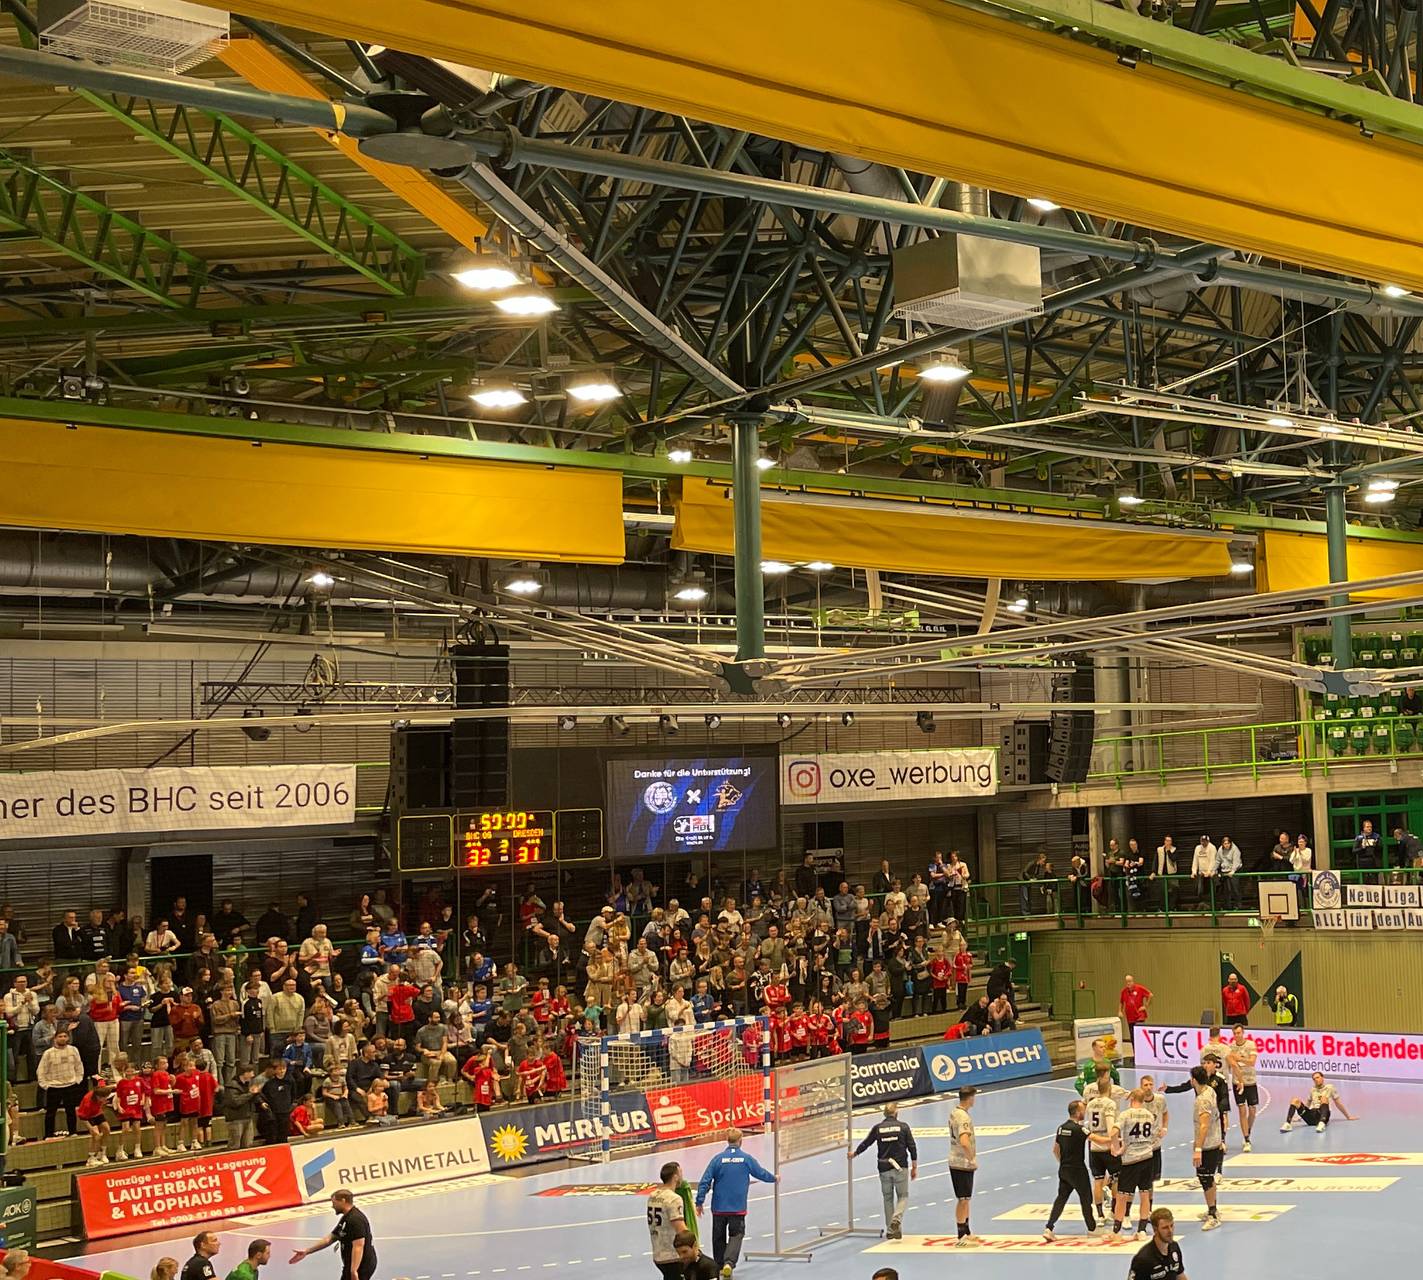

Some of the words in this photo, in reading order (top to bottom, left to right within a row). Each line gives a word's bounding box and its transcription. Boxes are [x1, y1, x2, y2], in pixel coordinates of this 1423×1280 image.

[634, 770, 662, 778] Danke
[663, 769, 675, 778] für
[677, 769, 690, 777] die
[829, 760, 992, 790] oxe_werbung
[56, 788, 115, 816] des
[129, 786, 197, 813] BHC
[209, 785, 264, 810] seit
[275, 782, 349, 808] 2006
[1349, 888, 1380, 903] Neue
[1387, 890, 1417, 905] Liga,
[1315, 913, 1342, 926] ALLE
[1350, 911, 1368, 926] für
[1377, 913, 1402, 927] den
[850, 1055, 920, 1079] Barmenia
[957, 1045, 1041, 1073] STORCH
[1260, 1058, 1360, 1074] www.brabender.net
[853, 1076, 914, 1098] Gothaer
[1129, 1122, 1152, 1139] 48
[106, 1174, 151, 1189] Umzüge
[162, 1165, 206, 1180] Logistik
[216, 1157, 267, 1172] Lagerung
[338, 1147, 480, 1184] RHEINMETALL
[108, 1174, 221, 1204] LAUTERBACH
[3, 1203, 21, 1217] AOK
[112, 1206, 125, 1220] &
[131, 1190, 224, 1217] KLOPHAUS
[647, 1207, 662, 1227] 55
